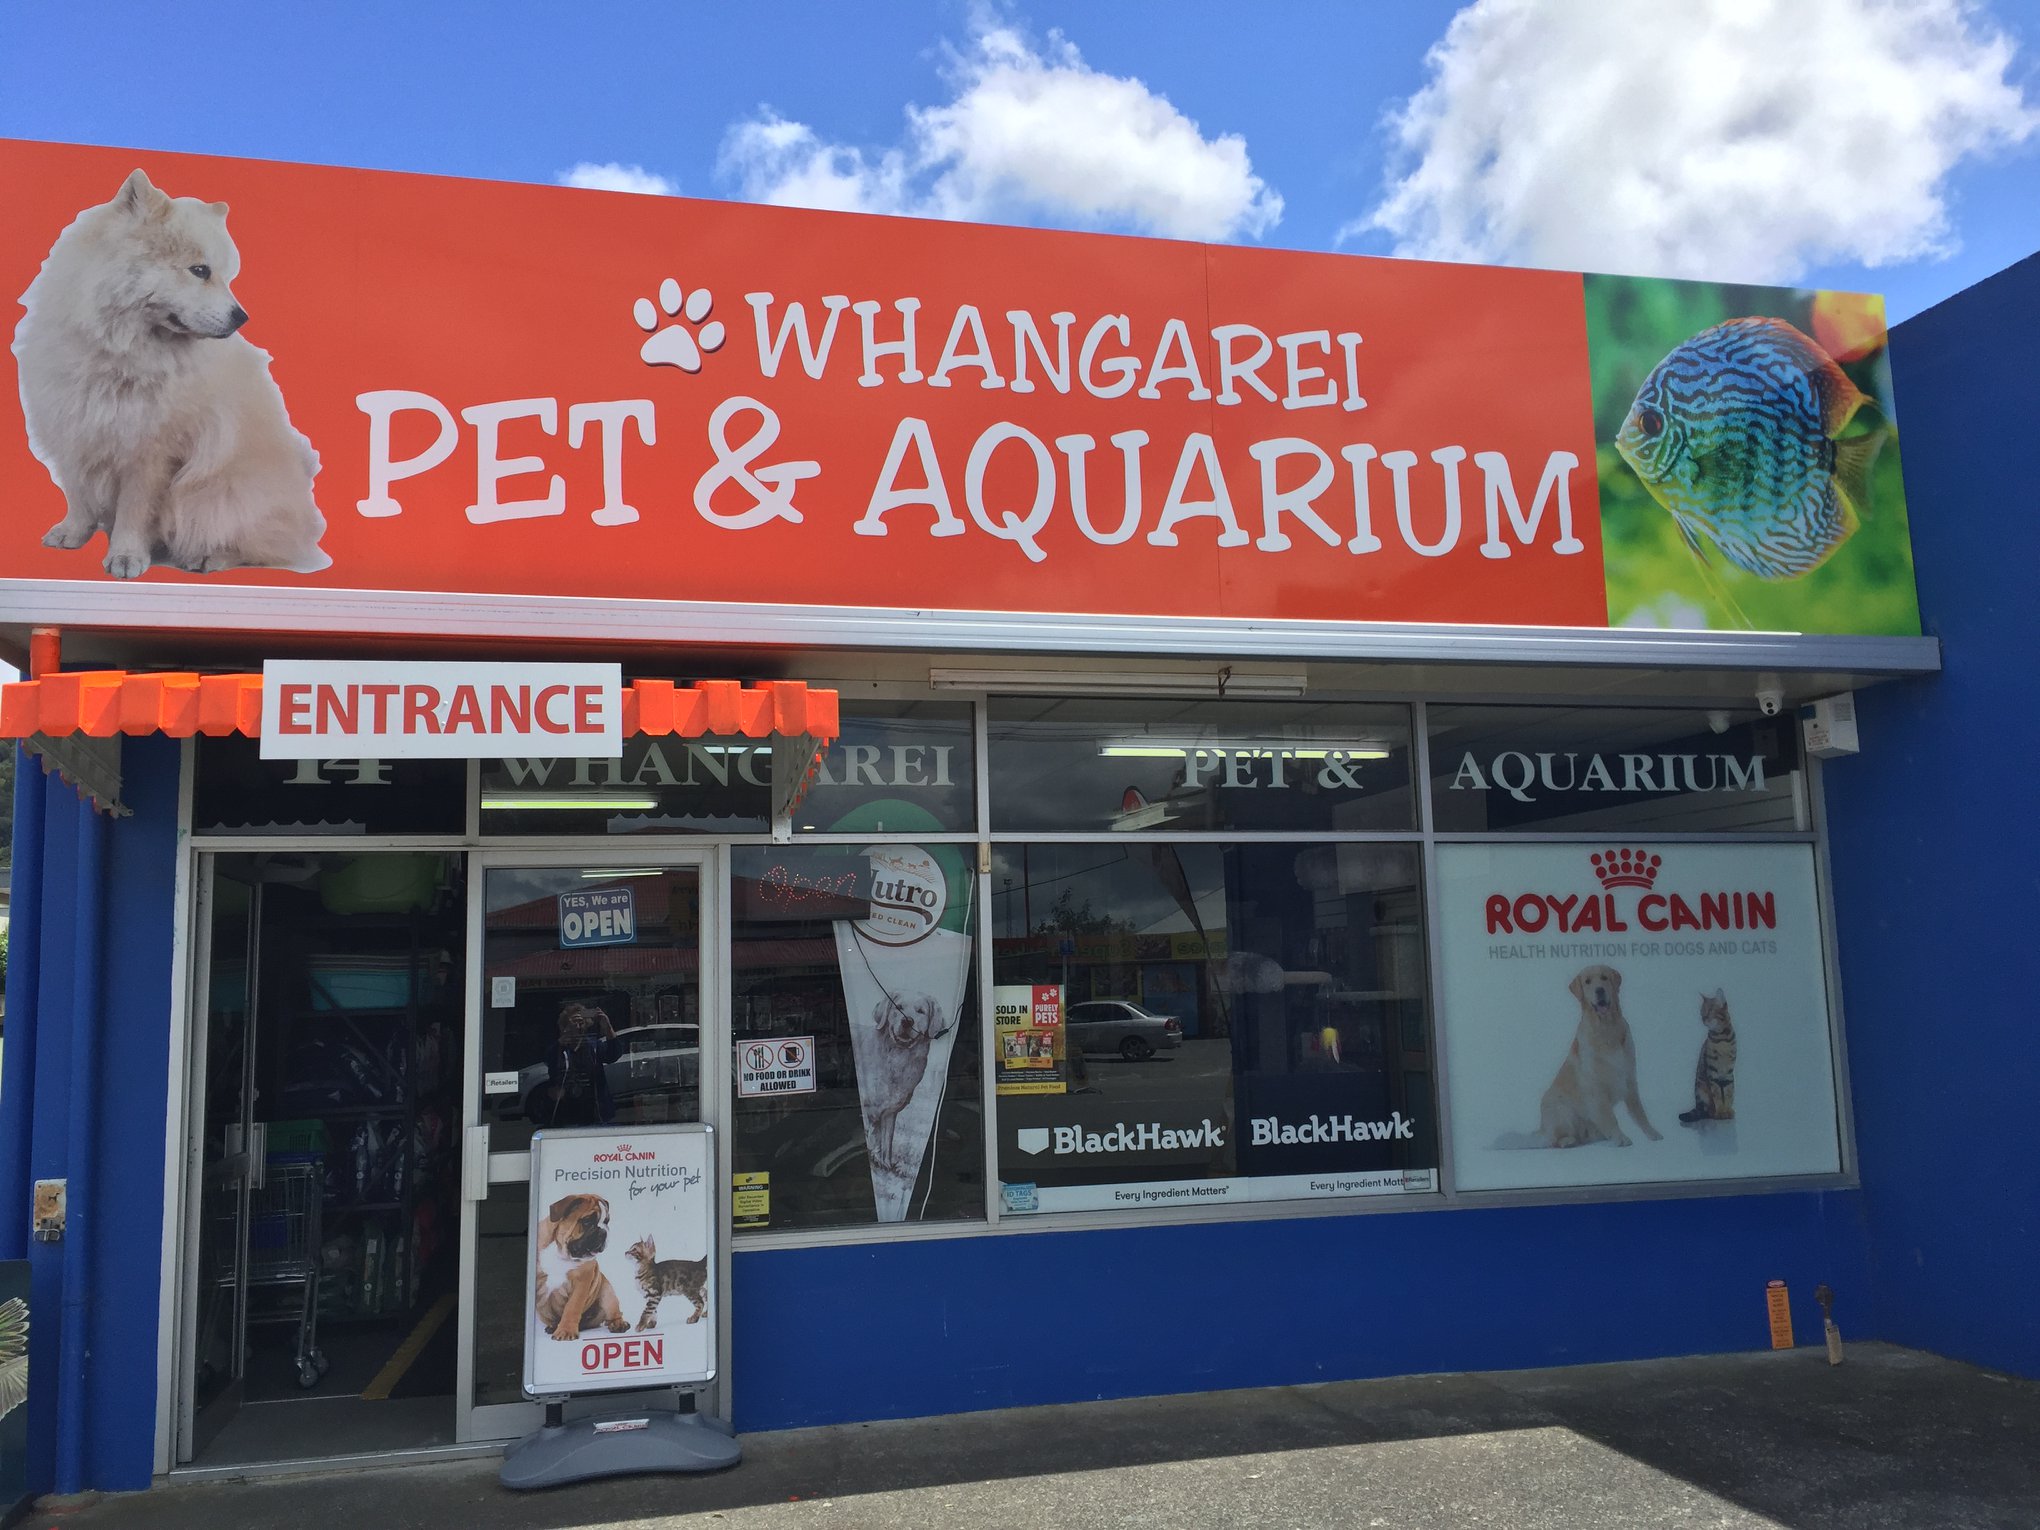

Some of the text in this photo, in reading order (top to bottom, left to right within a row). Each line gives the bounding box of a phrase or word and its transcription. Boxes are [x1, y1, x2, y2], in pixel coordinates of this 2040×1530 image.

[745, 291, 1368, 412] WHANGAREI
[355, 389, 1585, 563] PET & AQUARIUM
[278, 684, 605, 735] ENTRANCE
[1181, 747, 1297, 789] PET
[1317, 749, 1364, 789] &
[1449, 750, 1770, 801] AQUARIUM
[871, 868, 938, 908] utro
[563, 894, 629, 908] YES, We are
[871, 912, 917, 929] ED CLEAN
[1485, 891, 1777, 935] ROYAL CANIN
[563, 908, 632, 940] OPEN
[1488, 940, 1778, 960] HEALTH NUTRITION FOR DOGS AND CATS
[995, 1005, 1028, 1015] SOLD IN
[1035, 1003, 1059, 1012] PURELY
[995, 1015, 1021, 1025] STORE
[1035, 1012, 1059, 1024] PETS
[743, 1068, 811, 1082] NO FOOD OR DRINK
[760, 1080, 797, 1092] ALLOWED
[1053, 1118, 1226, 1155] BlackHawk
[1250, 1111, 1415, 1146] BlackHawk
[593, 1151, 656, 1163] ROYAL CANIN
[555, 1163, 687, 1182] Precision Nutrition
[629, 1168, 702, 1200] for your pet
[1115, 1186, 1227, 1201] Every Ingredient Matters
[1310, 1177, 1405, 1192] Every Ingredient Matt
[581, 1339, 663, 1370] OPEN
